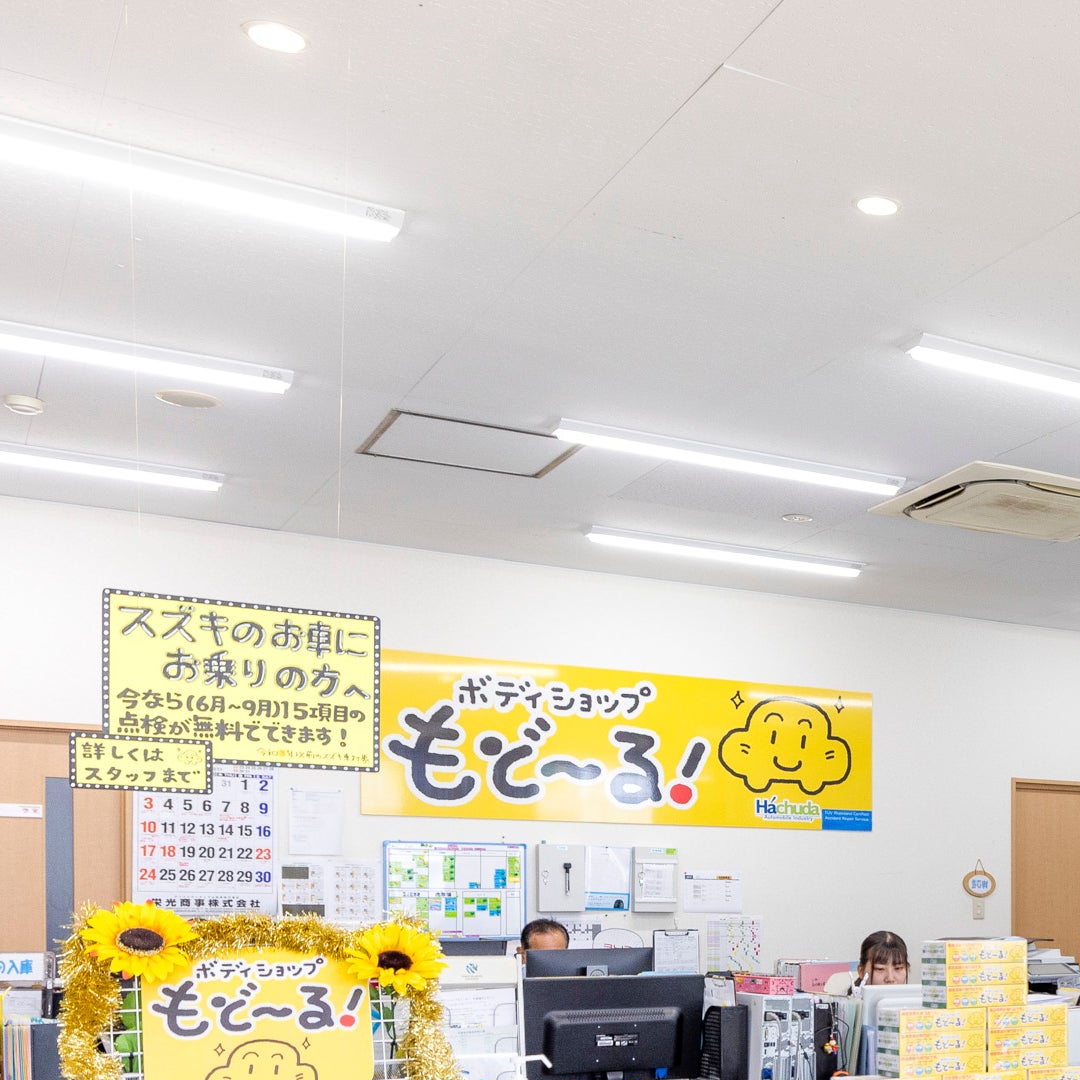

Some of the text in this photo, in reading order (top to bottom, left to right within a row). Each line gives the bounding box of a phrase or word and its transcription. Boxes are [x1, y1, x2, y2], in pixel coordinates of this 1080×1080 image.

[118, 604, 369, 659] スズキのお車に
[162, 647, 371, 700] お乗りの方へ
[458, 674, 652, 714] ボディショップ
[81, 741, 165, 764] 詳しくは
[84, 765, 201, 785] スタッフまで
[241, 779, 249, 791] 1
[259, 779, 269, 792] 2
[143, 797, 269, 815] 3 4 5 6 7 8 9
[756, 796, 820, 816] Háchuda
[140, 821, 272, 838] 10 11 12 13 14 15 16
[140, 845, 272, 860] 17 18 19 20 21 22 23
[139, 868, 272, 884] 24 25 26 27 28 29 30
[152, 898, 261, 909] 栄光商事株式会社
[195, 957, 326, 979] ボディショップ
